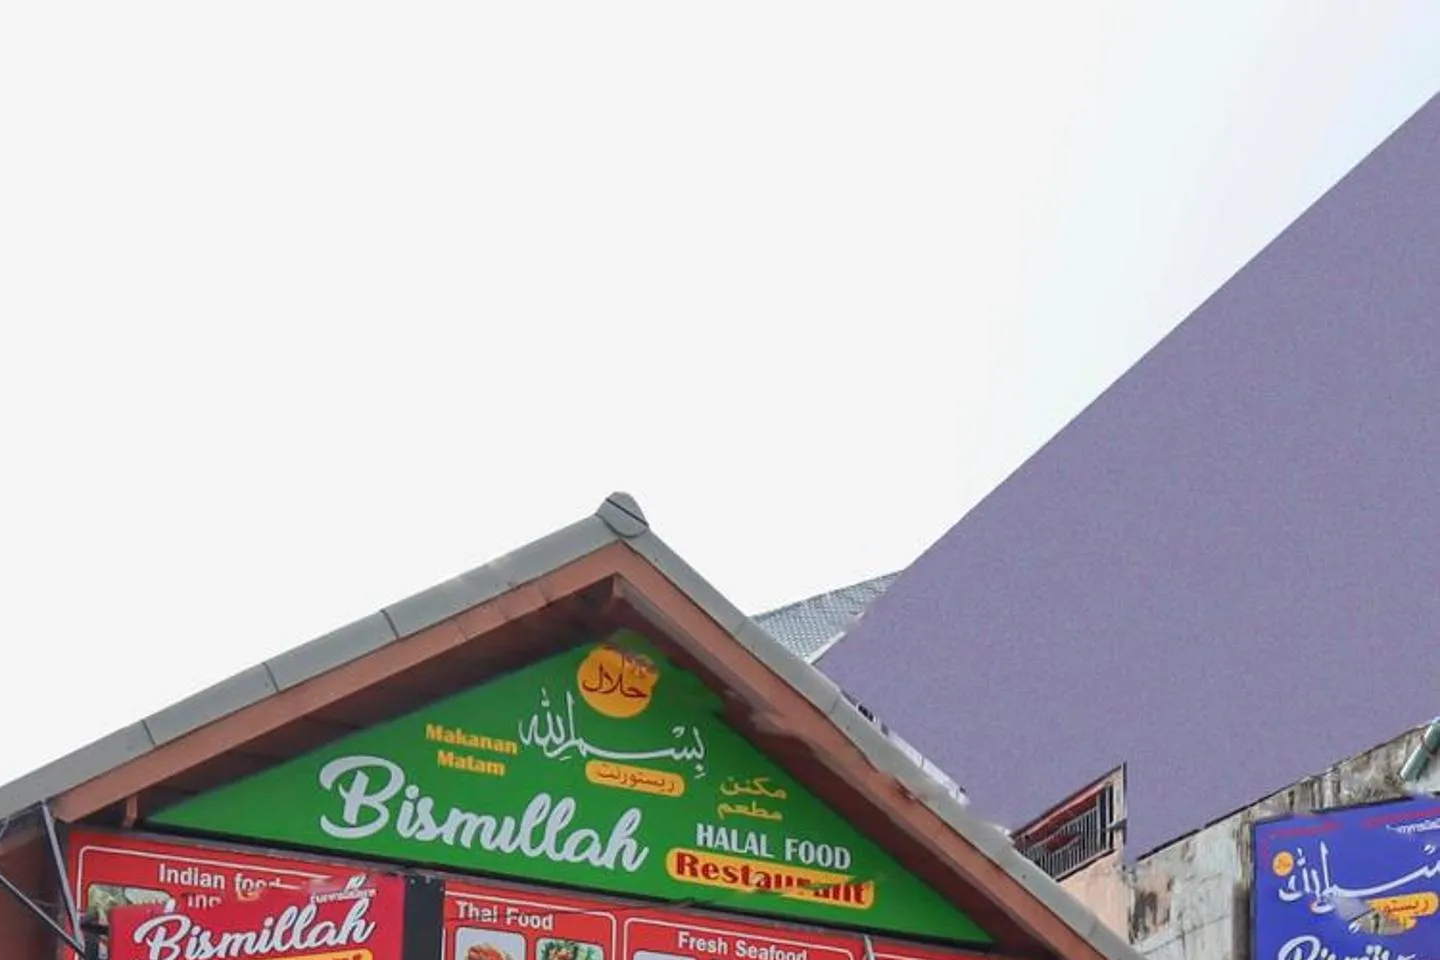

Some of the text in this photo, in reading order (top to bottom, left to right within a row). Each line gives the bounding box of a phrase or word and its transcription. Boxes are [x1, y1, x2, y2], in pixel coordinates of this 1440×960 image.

[425, 722, 518, 756] Makanan
[436, 749, 506, 778] Matam
[319, 755, 649, 872] Bismillah
[696, 823, 851, 870] HALAL FOOD
[159, 864, 225, 889] Indian
[456, 901, 553, 931] Thai Food
[678, 931, 728, 955] Fresh
